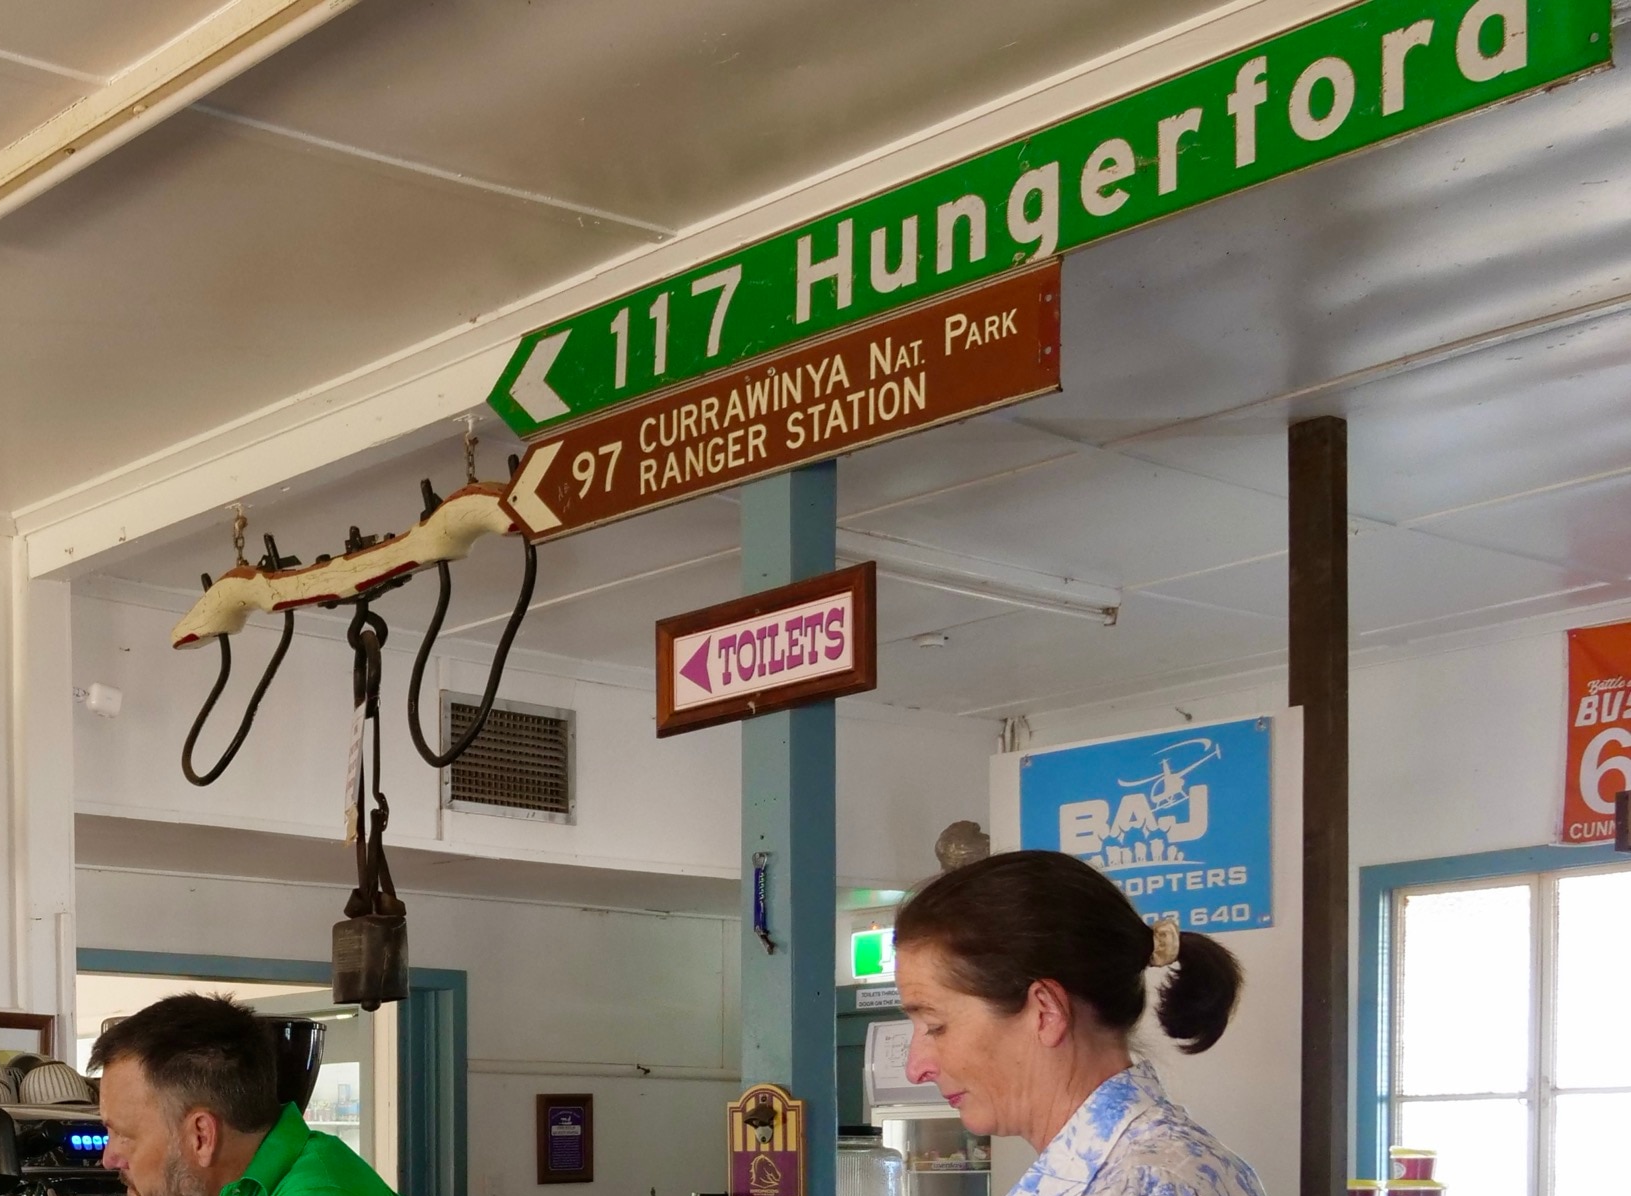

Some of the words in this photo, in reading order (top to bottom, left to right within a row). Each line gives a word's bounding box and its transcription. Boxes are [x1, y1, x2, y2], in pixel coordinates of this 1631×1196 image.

[609, 265, 743, 389] 117
[795, 0, 1528, 324] Hungerford
[639, 353, 851, 451] CURRAWINYA
[944, 308, 1019, 357] PARK
[571, 443, 623, 499] 97
[639, 425, 768, 495] RANGER
[785, 372, 928, 450] STATION
[718, 606, 846, 686] TOILETS
[1059, 784, 1209, 855] BAJ
[1189, 903, 1251, 927] 640
